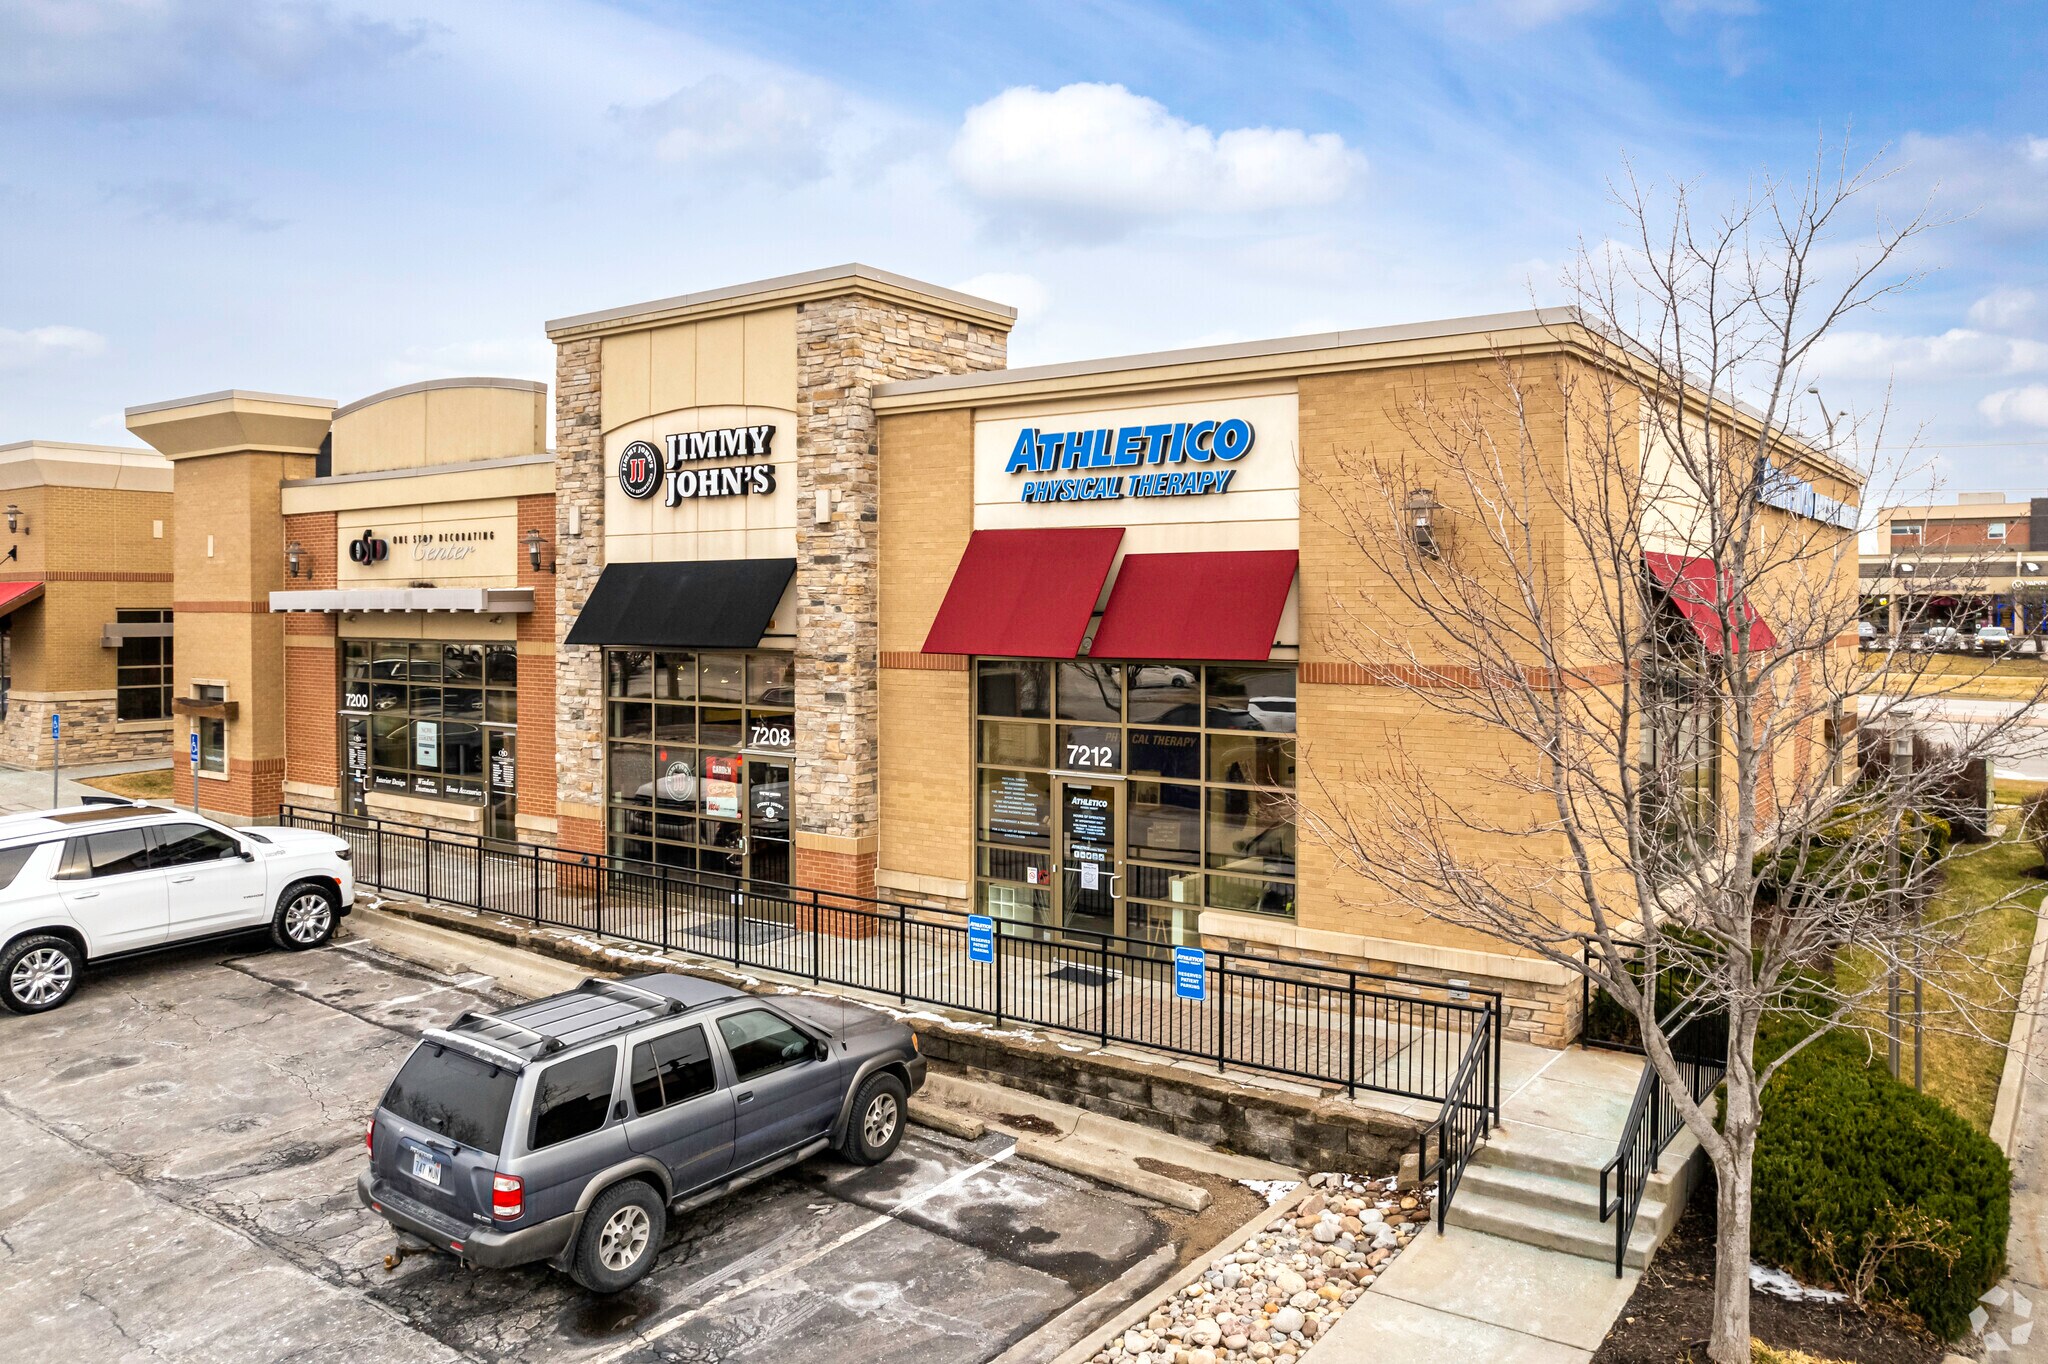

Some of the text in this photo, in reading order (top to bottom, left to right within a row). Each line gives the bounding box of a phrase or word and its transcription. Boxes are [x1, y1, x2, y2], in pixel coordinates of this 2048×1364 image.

[666, 425, 775, 469] JIMMY
[1004, 418, 1255, 474] ATHLETICO
[630, 459, 646, 483] JJ
[665, 464, 776, 507] JOHN'S
[1021, 470, 1236, 502] PHYSICAL THERAPY
[393, 531, 495, 545] ONE STOP DECORATING
[412, 539, 476, 561] Center
[346, 693, 368, 708] 7200
[751, 727, 791, 747] 7208
[1152, 735, 1197, 747] THERAPY
[1067, 744, 1113, 767] 7212
[1071, 797, 1108, 807] ATHLETICO
[1177, 954, 1203, 963] ATHLETICO
[1178, 971, 1202, 979] RESERVED
